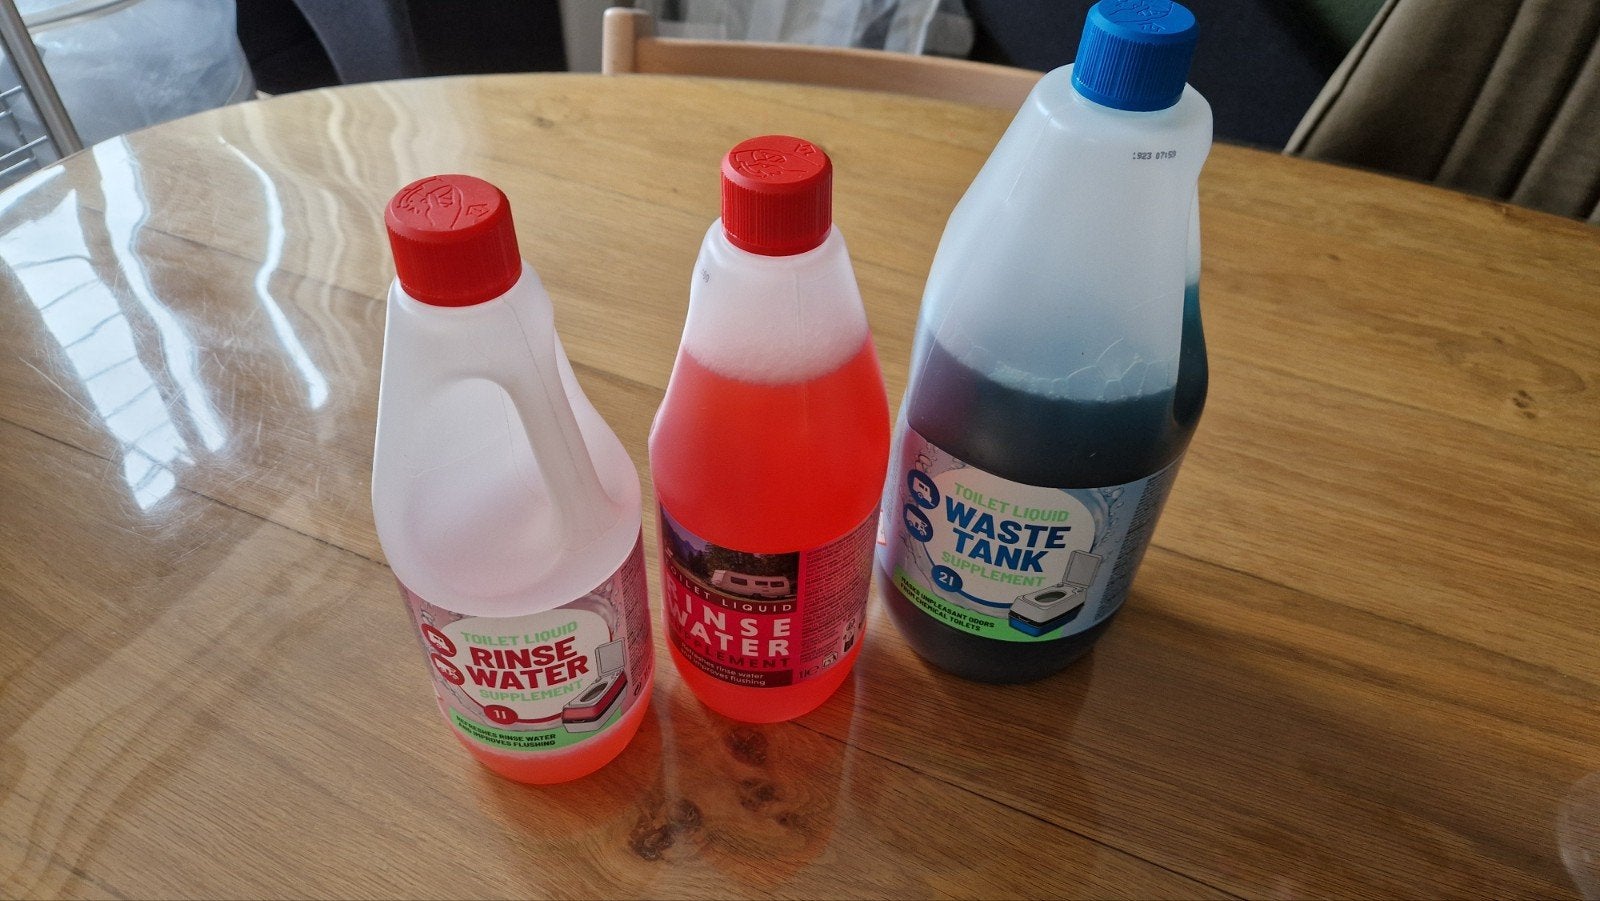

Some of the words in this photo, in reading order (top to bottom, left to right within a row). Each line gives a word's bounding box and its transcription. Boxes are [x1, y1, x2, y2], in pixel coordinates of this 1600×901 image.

[954, 482, 1010, 514] TOILET
[1012, 505, 1070, 523] LIQUID
[945, 495, 1072, 550] WASTE
[952, 527, 1051, 573] TANK
[941, 551, 1046, 588] SUPPLEMENT
[666, 573, 791, 638] RINSE
[722, 598, 792, 613] LIQUID
[901, 576, 921, 597] MASKS
[920, 594, 968, 620] UNPLEASANT
[968, 617, 995, 628] ODORS
[915, 596, 948, 620] CHEMICAL
[950, 616, 981, 631] TOILETS
[461, 631, 519, 646] TOILET
[524, 621, 578, 643] LIQUID
[667, 592, 790, 657] WATER
[469, 636, 578, 670] RINSE
[465, 655, 590, 690] WATER
[693, 658, 729, 680] improves
[730, 675, 766, 686] flushing
[716, 664, 737, 675] rinse
[738, 671, 764, 679] water
[479, 679, 585, 703] SUPPLEMENT
[456, 715, 498, 738] REFRESHES
[499, 733, 524, 742] RINSE
[525, 733, 556, 742] WATER
[473, 731, 512, 747] IMPROVES
[513, 740, 556, 748] FLUSHING
